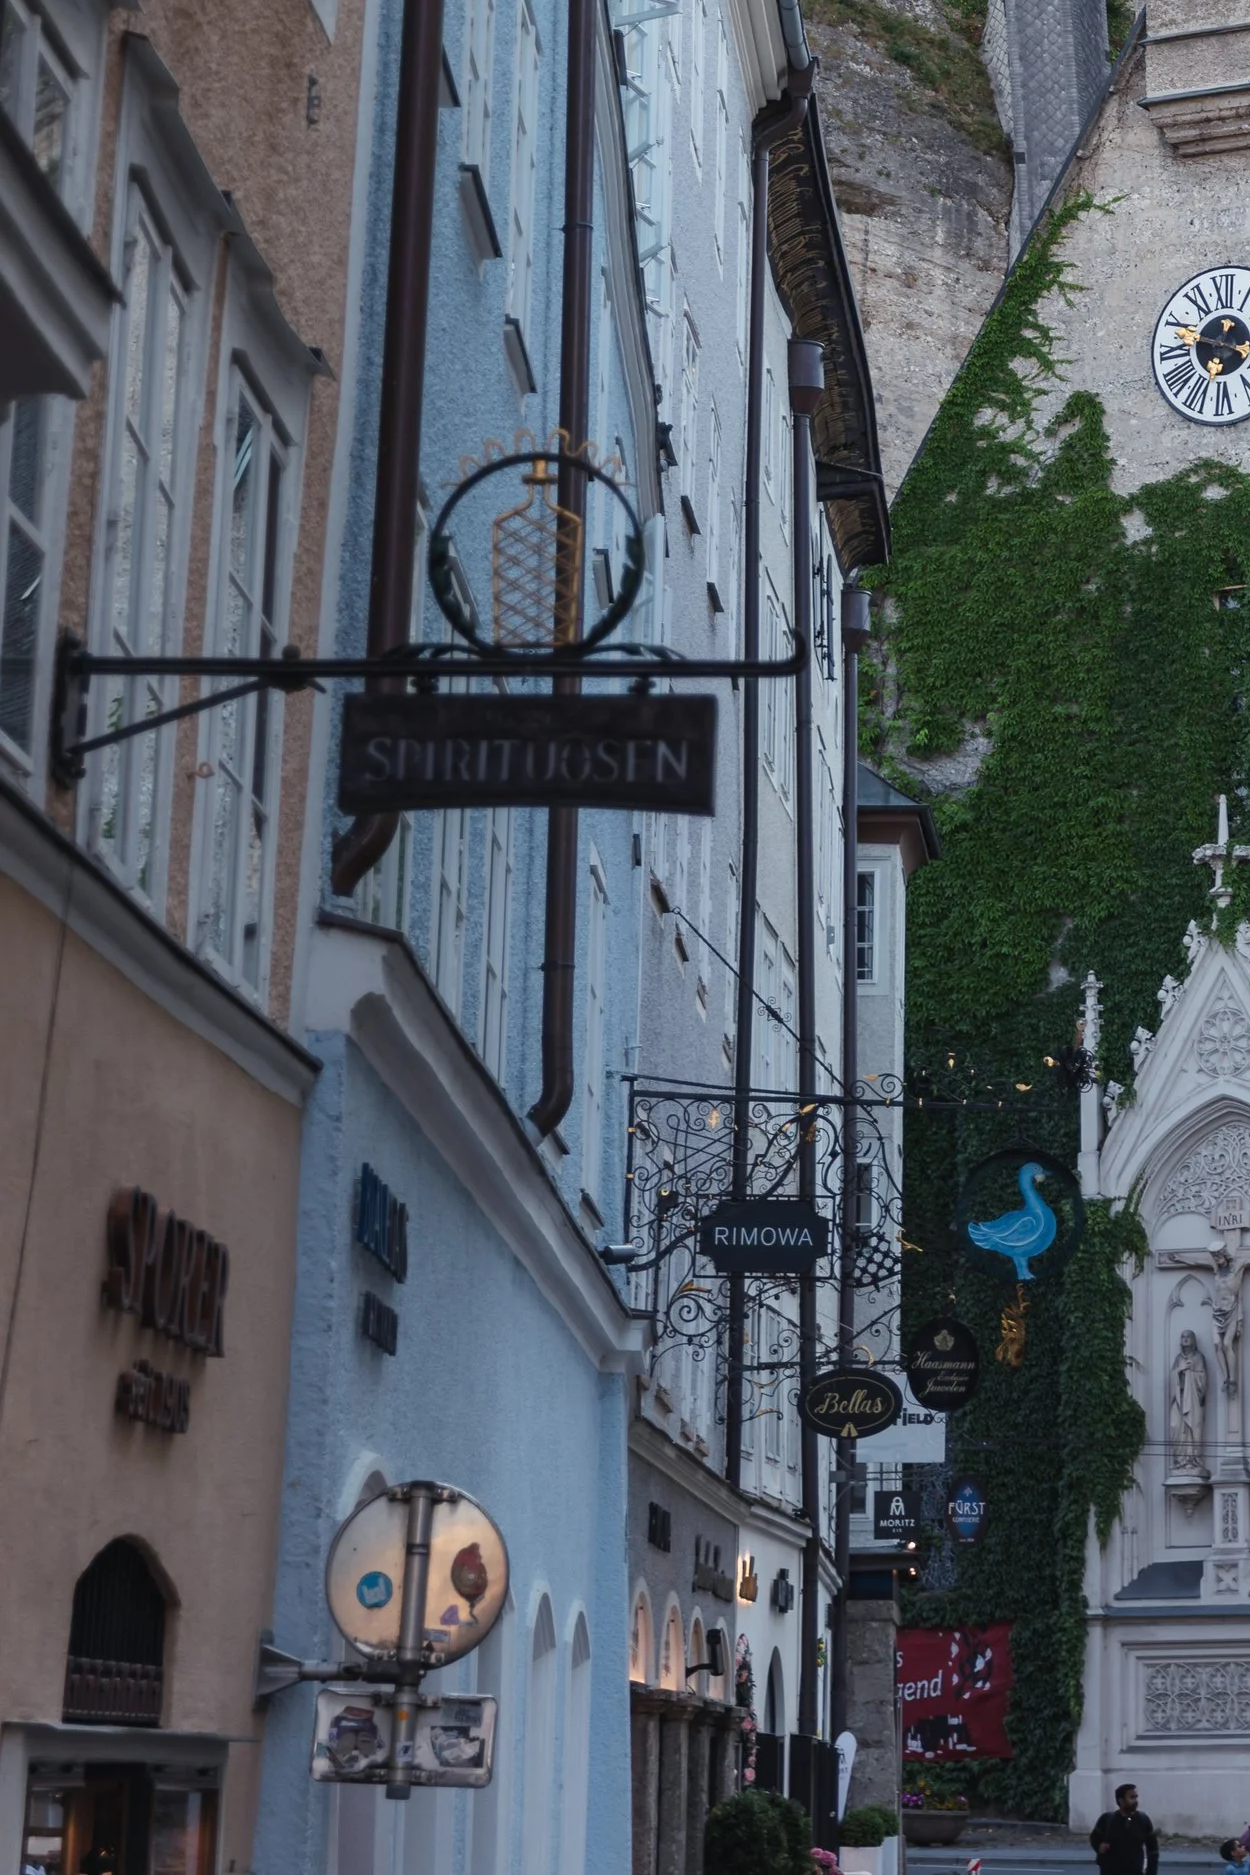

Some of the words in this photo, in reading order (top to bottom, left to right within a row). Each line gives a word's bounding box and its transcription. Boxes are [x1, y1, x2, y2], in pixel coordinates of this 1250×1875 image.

[714, 1226, 814, 1247] RIMOWA
[814, 1389, 887, 1414] Bellas
[948, 1500, 986, 1515] FÜRST
[880, 1519, 916, 1527] MORITZ
